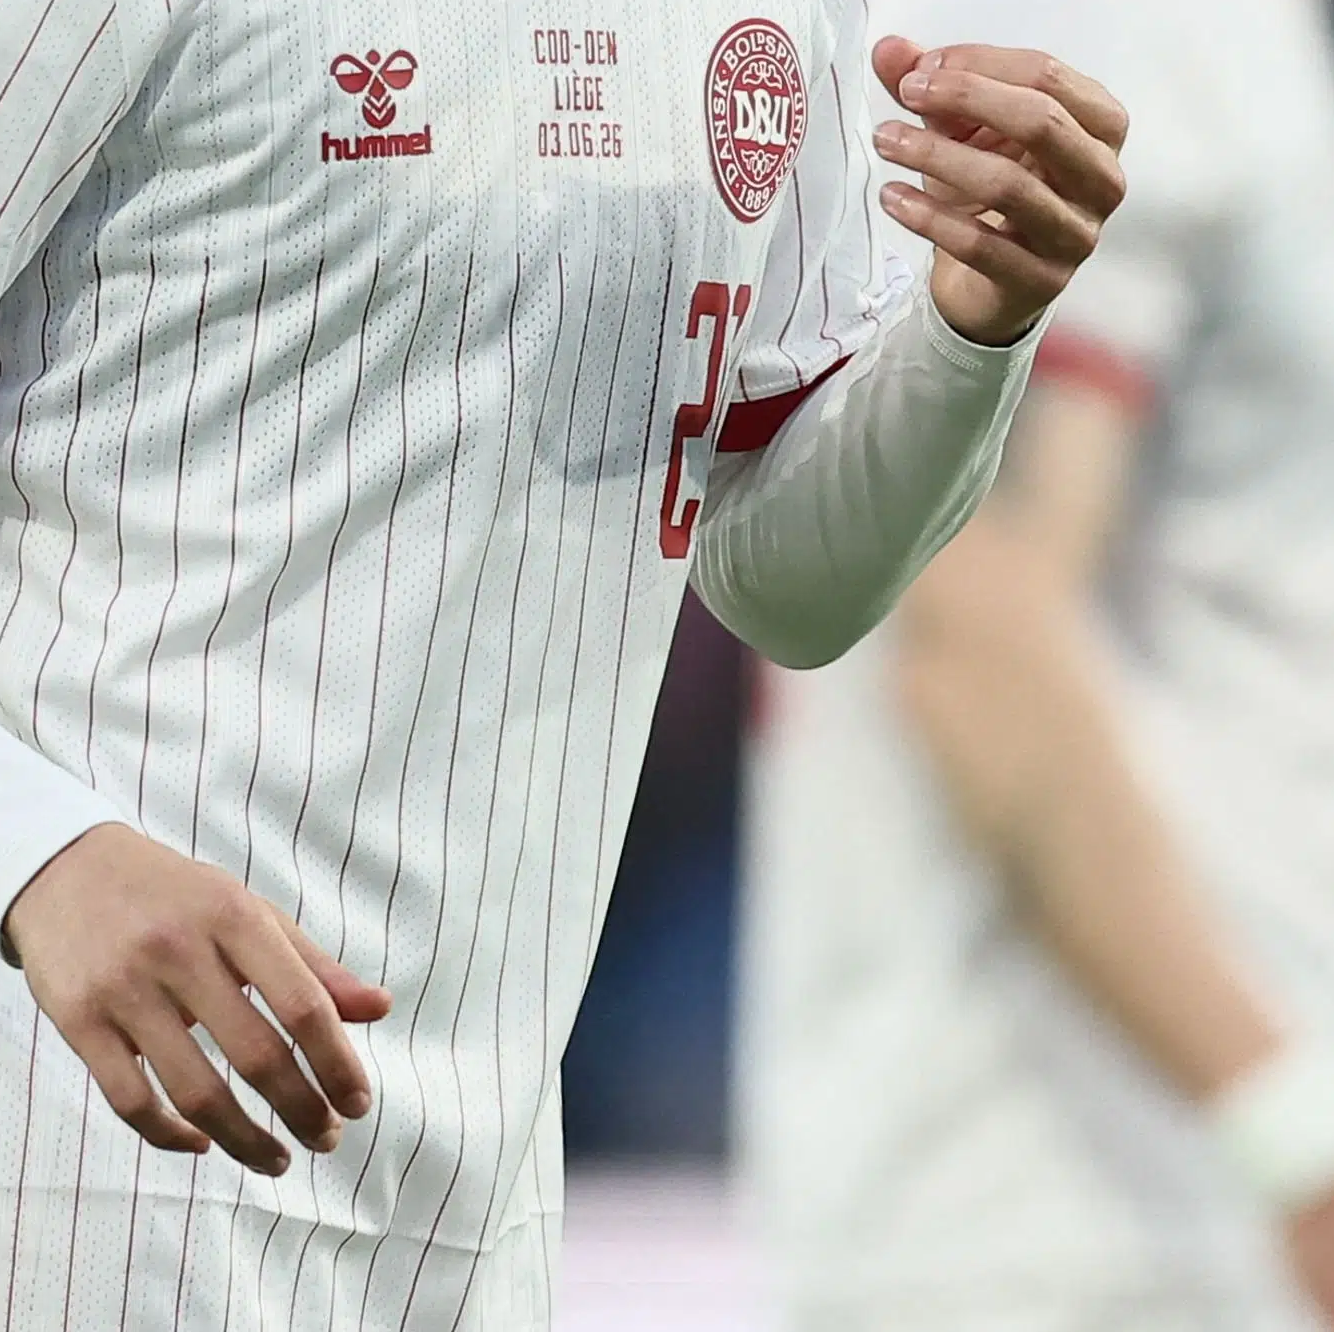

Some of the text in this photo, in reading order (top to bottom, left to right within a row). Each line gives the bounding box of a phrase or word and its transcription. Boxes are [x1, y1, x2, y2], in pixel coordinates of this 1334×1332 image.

[533, 29, 618, 65] COD-DEN
[554, 68, 604, 111] LIÈGE
[713, 73, 739, 186] DANSK
[733, 88, 790, 147] DBU
[321, 124, 432, 162] hummel
[538, 122, 622, 159] 03.06.26
[738, 184, 770, 210] 1889
[659, 281, 752, 559] 2
